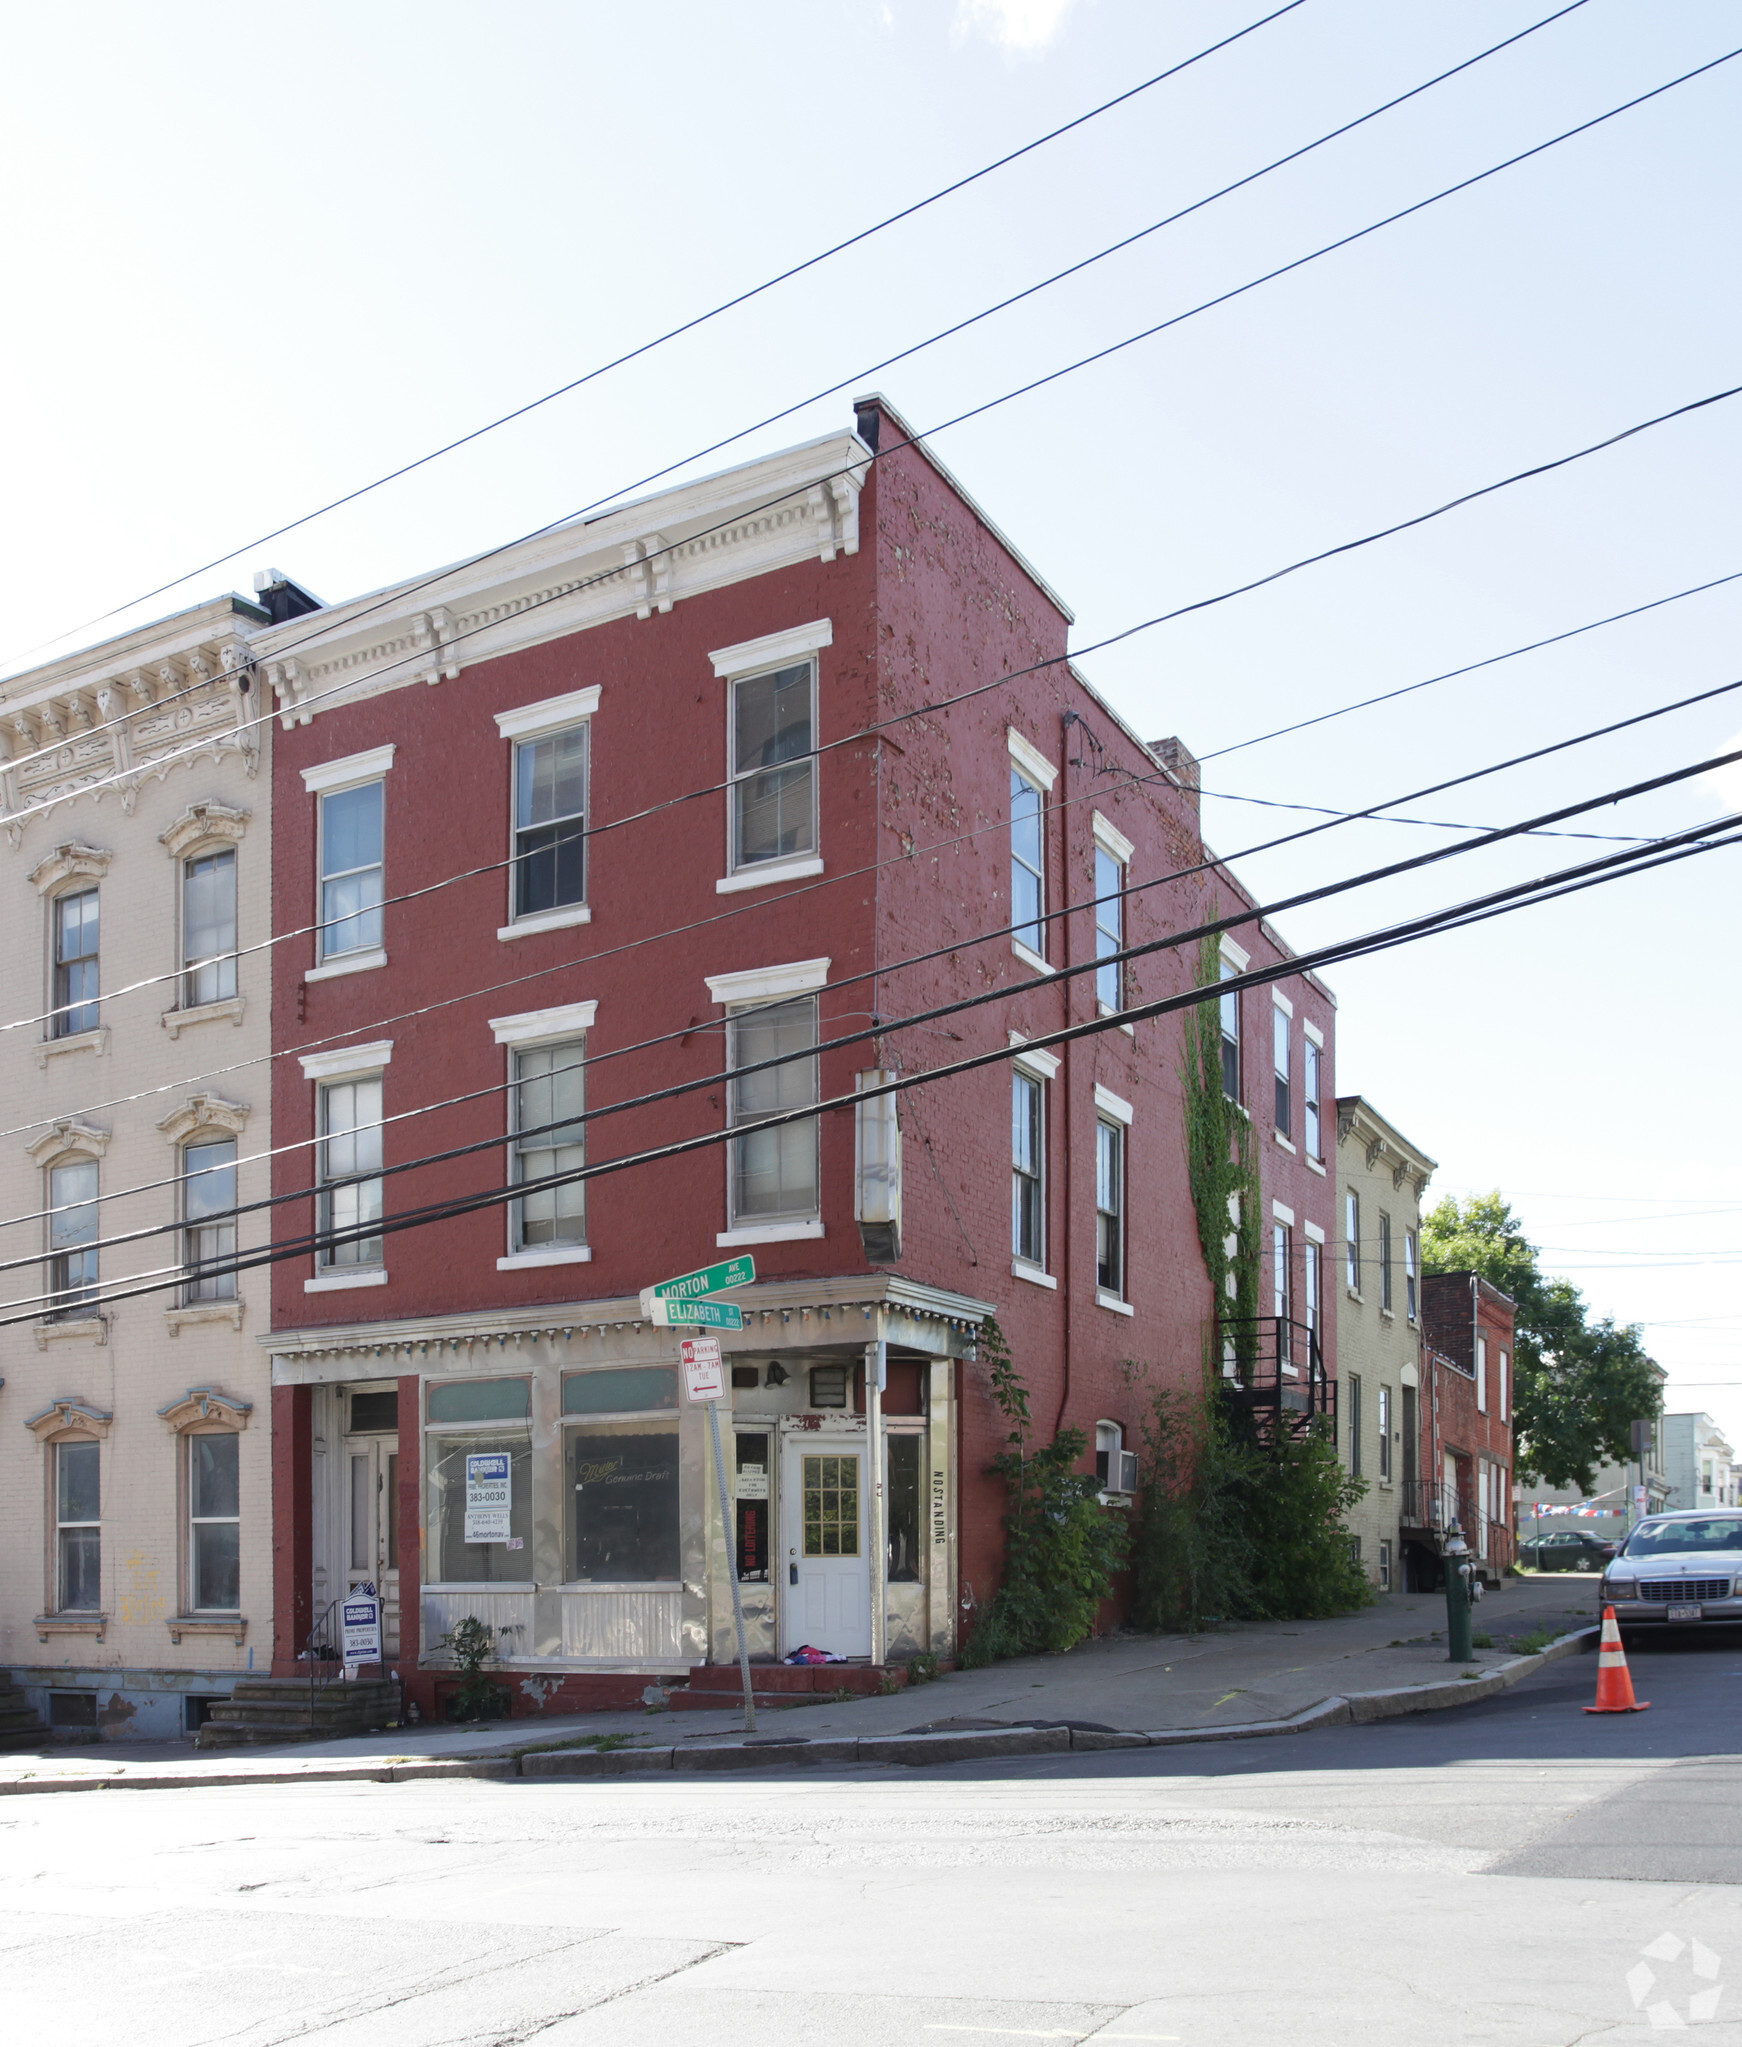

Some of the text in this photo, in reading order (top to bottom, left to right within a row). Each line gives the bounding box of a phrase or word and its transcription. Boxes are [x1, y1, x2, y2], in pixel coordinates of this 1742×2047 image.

[728, 1262, 740, 1273] AVE
[725, 1272, 746, 1285] 00222
[662, 1274, 709, 1298] MORTON
[669, 1304, 721, 1322] ELIZABETH
[682, 1344, 718, 1359] NO PARKING
[686, 1363, 702, 1372] 12AM
[707, 1361, 720, 1369] 7AM
[699, 1372, 710, 1380] TUE
[470, 1459, 504, 1467] COLDWELL
[605, 1470, 670, 1484] Genuine Draft
[470, 1492, 506, 1502] 383-0030
[745, 1510, 756, 1566] NO LOITERING
